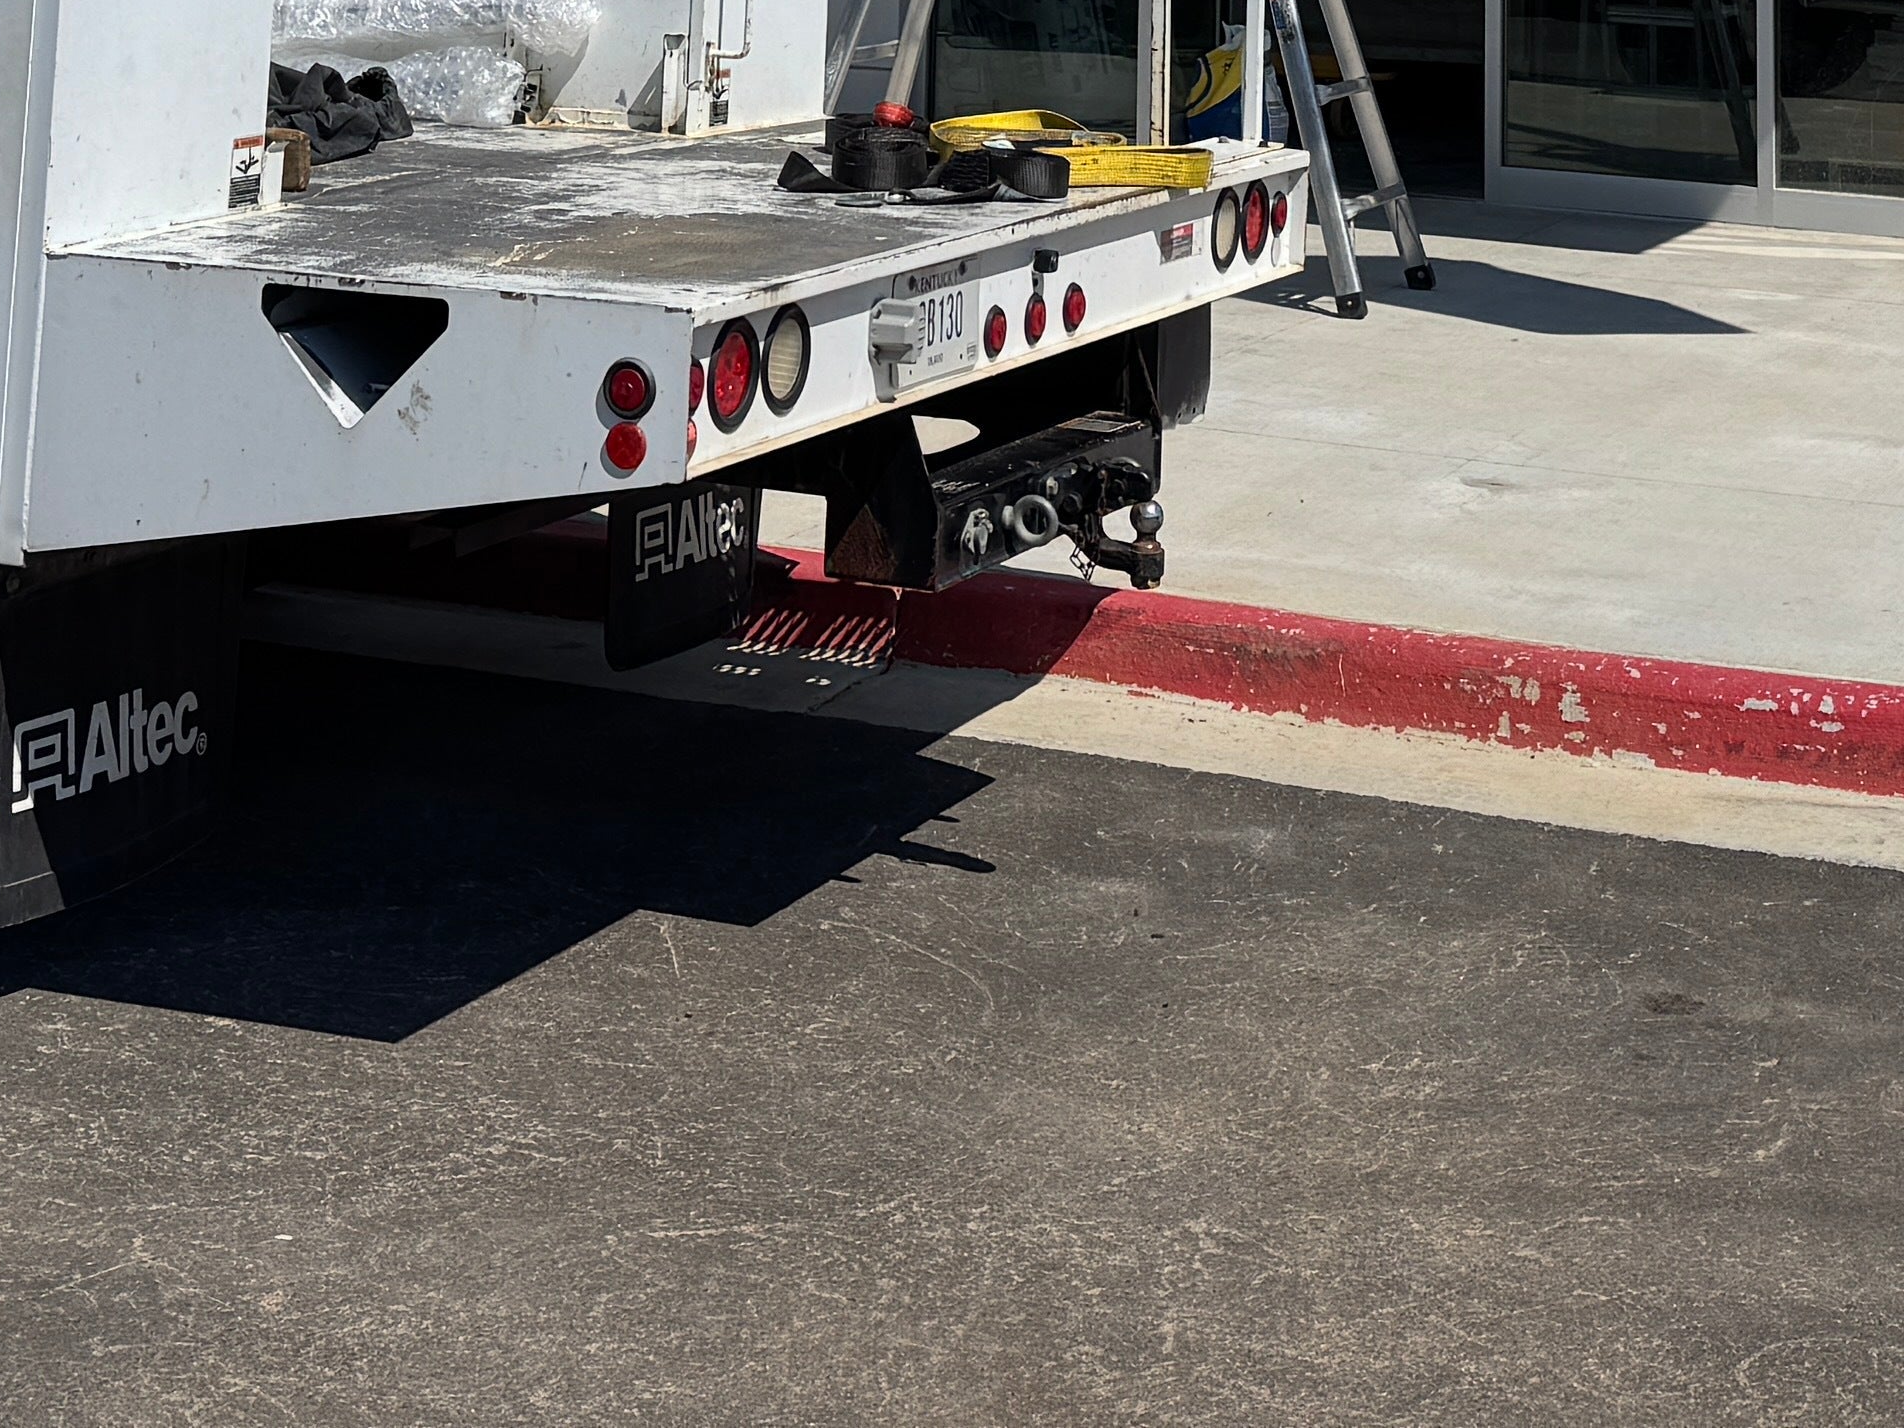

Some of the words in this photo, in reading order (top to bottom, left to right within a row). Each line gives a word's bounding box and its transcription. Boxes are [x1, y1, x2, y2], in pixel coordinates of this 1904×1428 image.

[915, 269, 959, 294] KENTUCKY
[675, 490, 745, 570] Altec
[79, 687, 199, 794] Altec
